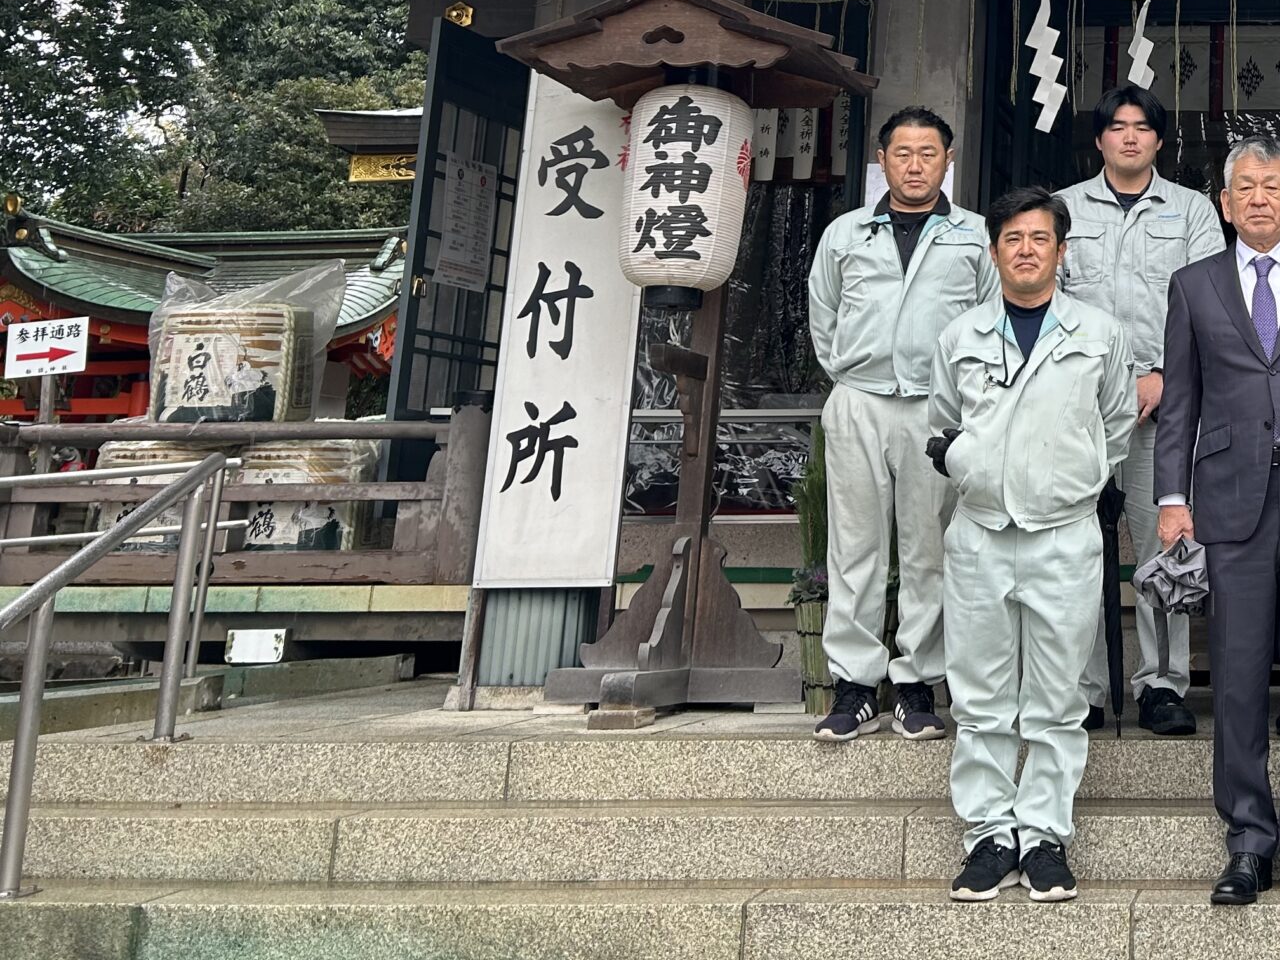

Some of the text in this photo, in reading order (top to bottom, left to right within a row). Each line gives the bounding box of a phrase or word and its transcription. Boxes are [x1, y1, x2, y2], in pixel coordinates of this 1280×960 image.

[632, 96, 723, 260] 御神燈
[16, 323, 82, 344] 参拝通路
[499, 125, 610, 502] 受付所
[182, 342, 211, 402] 白鶴
